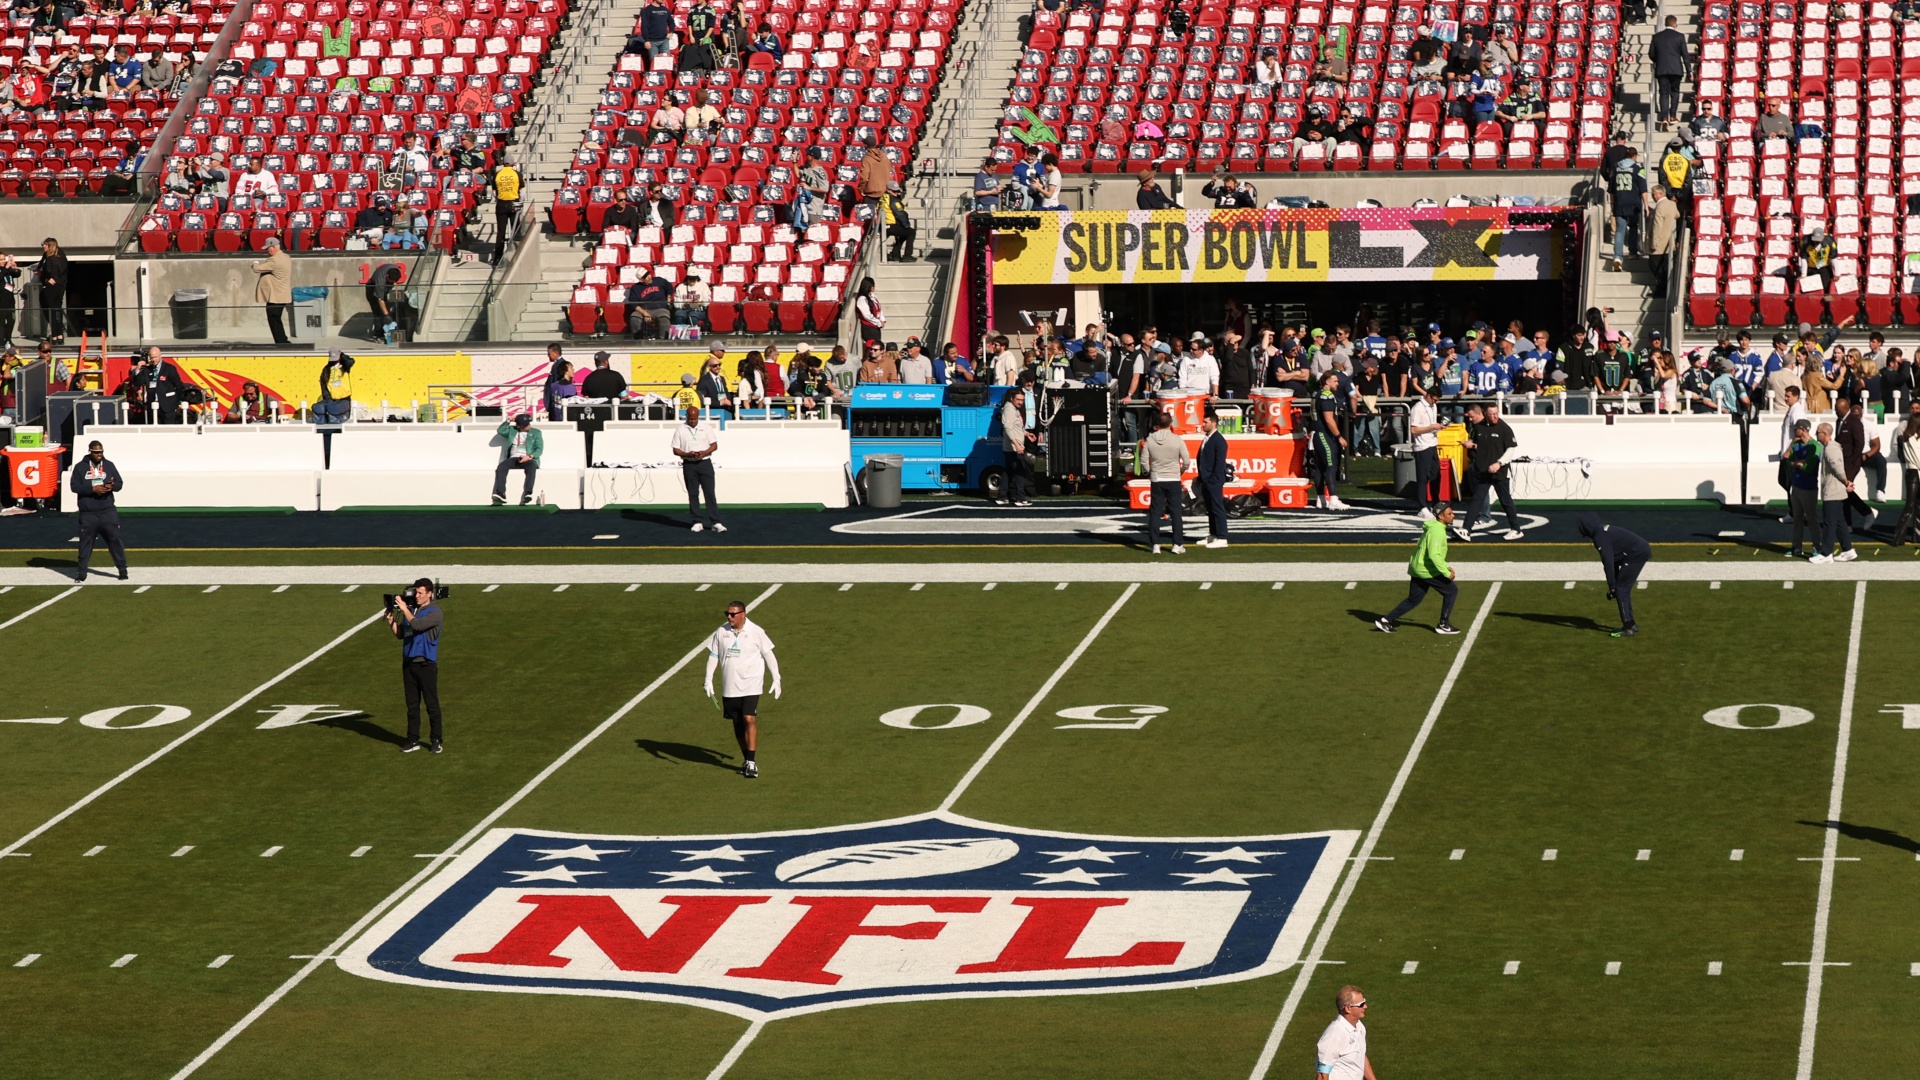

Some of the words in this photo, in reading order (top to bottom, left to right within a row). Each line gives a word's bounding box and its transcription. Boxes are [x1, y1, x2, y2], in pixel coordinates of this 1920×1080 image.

[692, 14, 707, 31] 21
[1063, 221, 1190, 273] SUPER
[1204, 220, 1318, 270] BOWL
[836, 370, 854, 391] 10
[1477, 371, 1497, 391] 10
[1603, 364, 1621, 387] 11
[1184, 401, 1195, 413] G
[1269, 402, 1281, 416] G
[17, 460, 40, 486] G
[1138, 490, 1151, 506] G
[1278, 489, 1293, 504] G
[451, 893, 1185, 986] NFL
